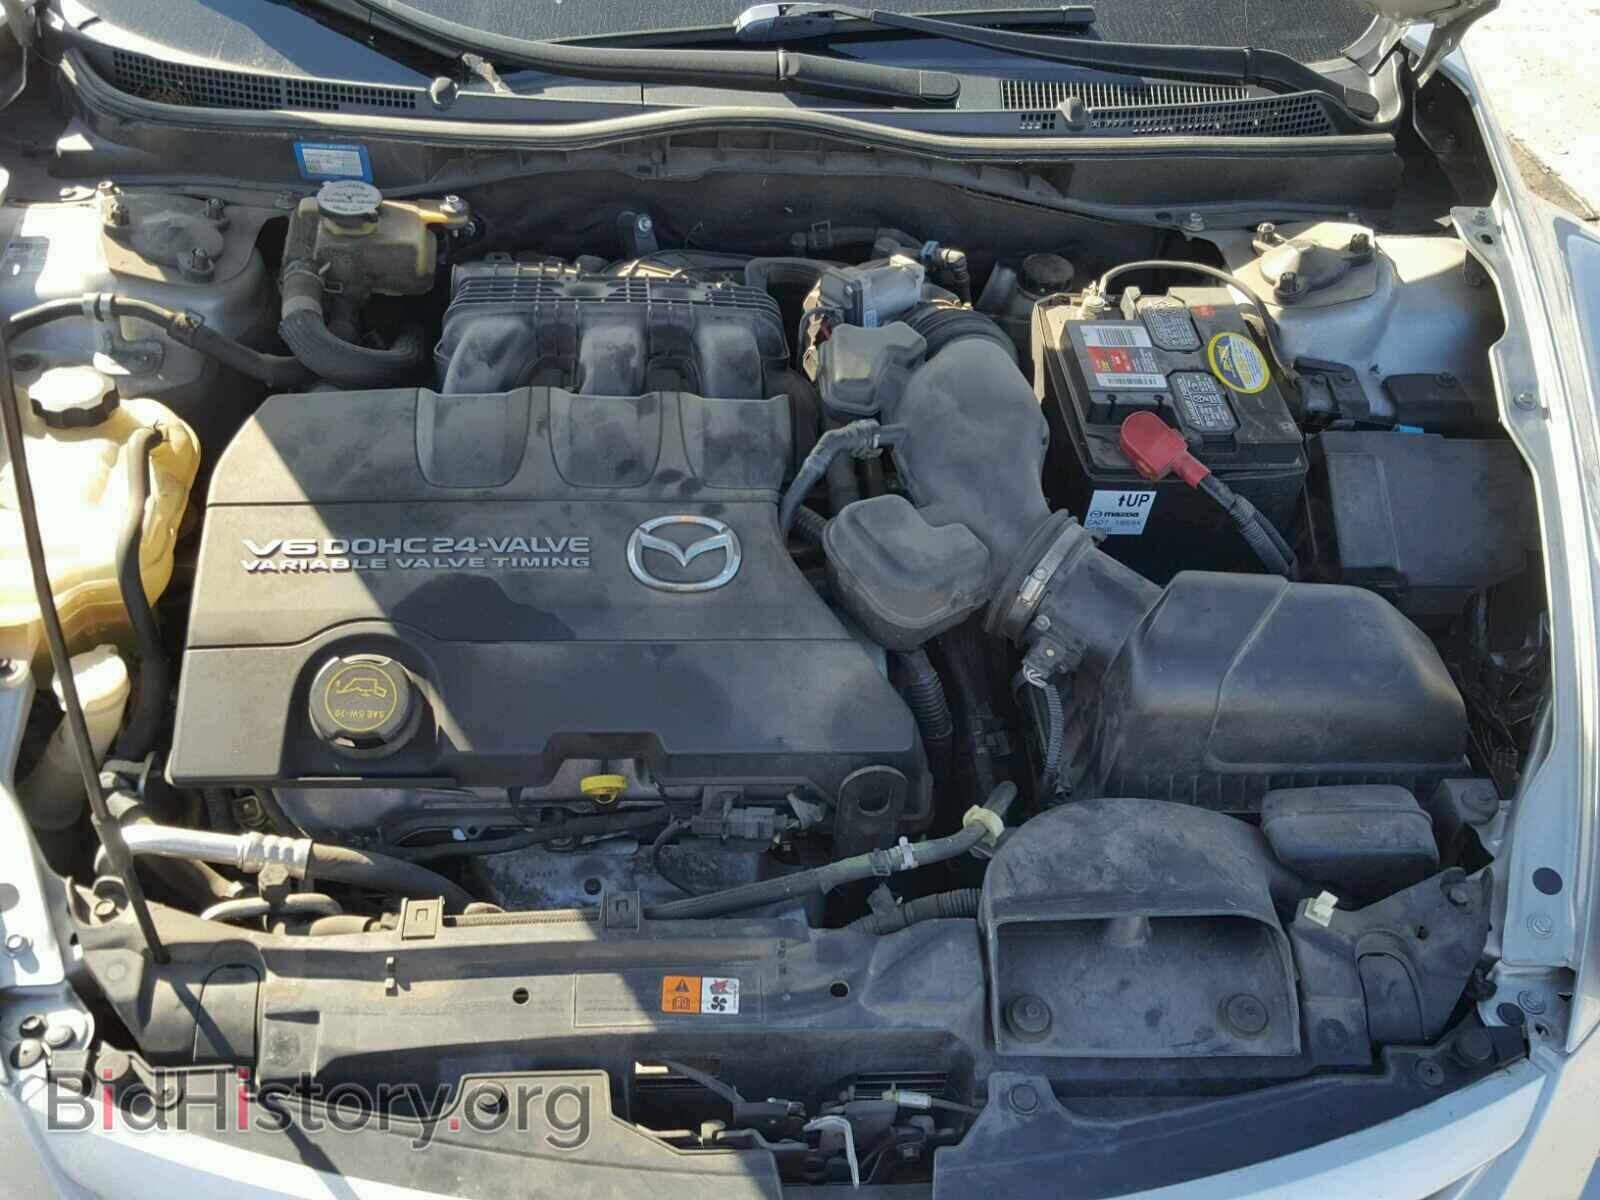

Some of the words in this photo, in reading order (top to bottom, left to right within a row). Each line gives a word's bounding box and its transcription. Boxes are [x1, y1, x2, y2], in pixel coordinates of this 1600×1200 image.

[1126, 493, 1150, 507] UP
[241, 538, 318, 557] V6
[323, 537, 427, 555] DOHC
[432, 536, 590, 553] 24-VALVE
[241, 558, 388, 572] VARIABLE
[395, 557, 486, 570] VALVE
[493, 556, 590, 569] TIMING
